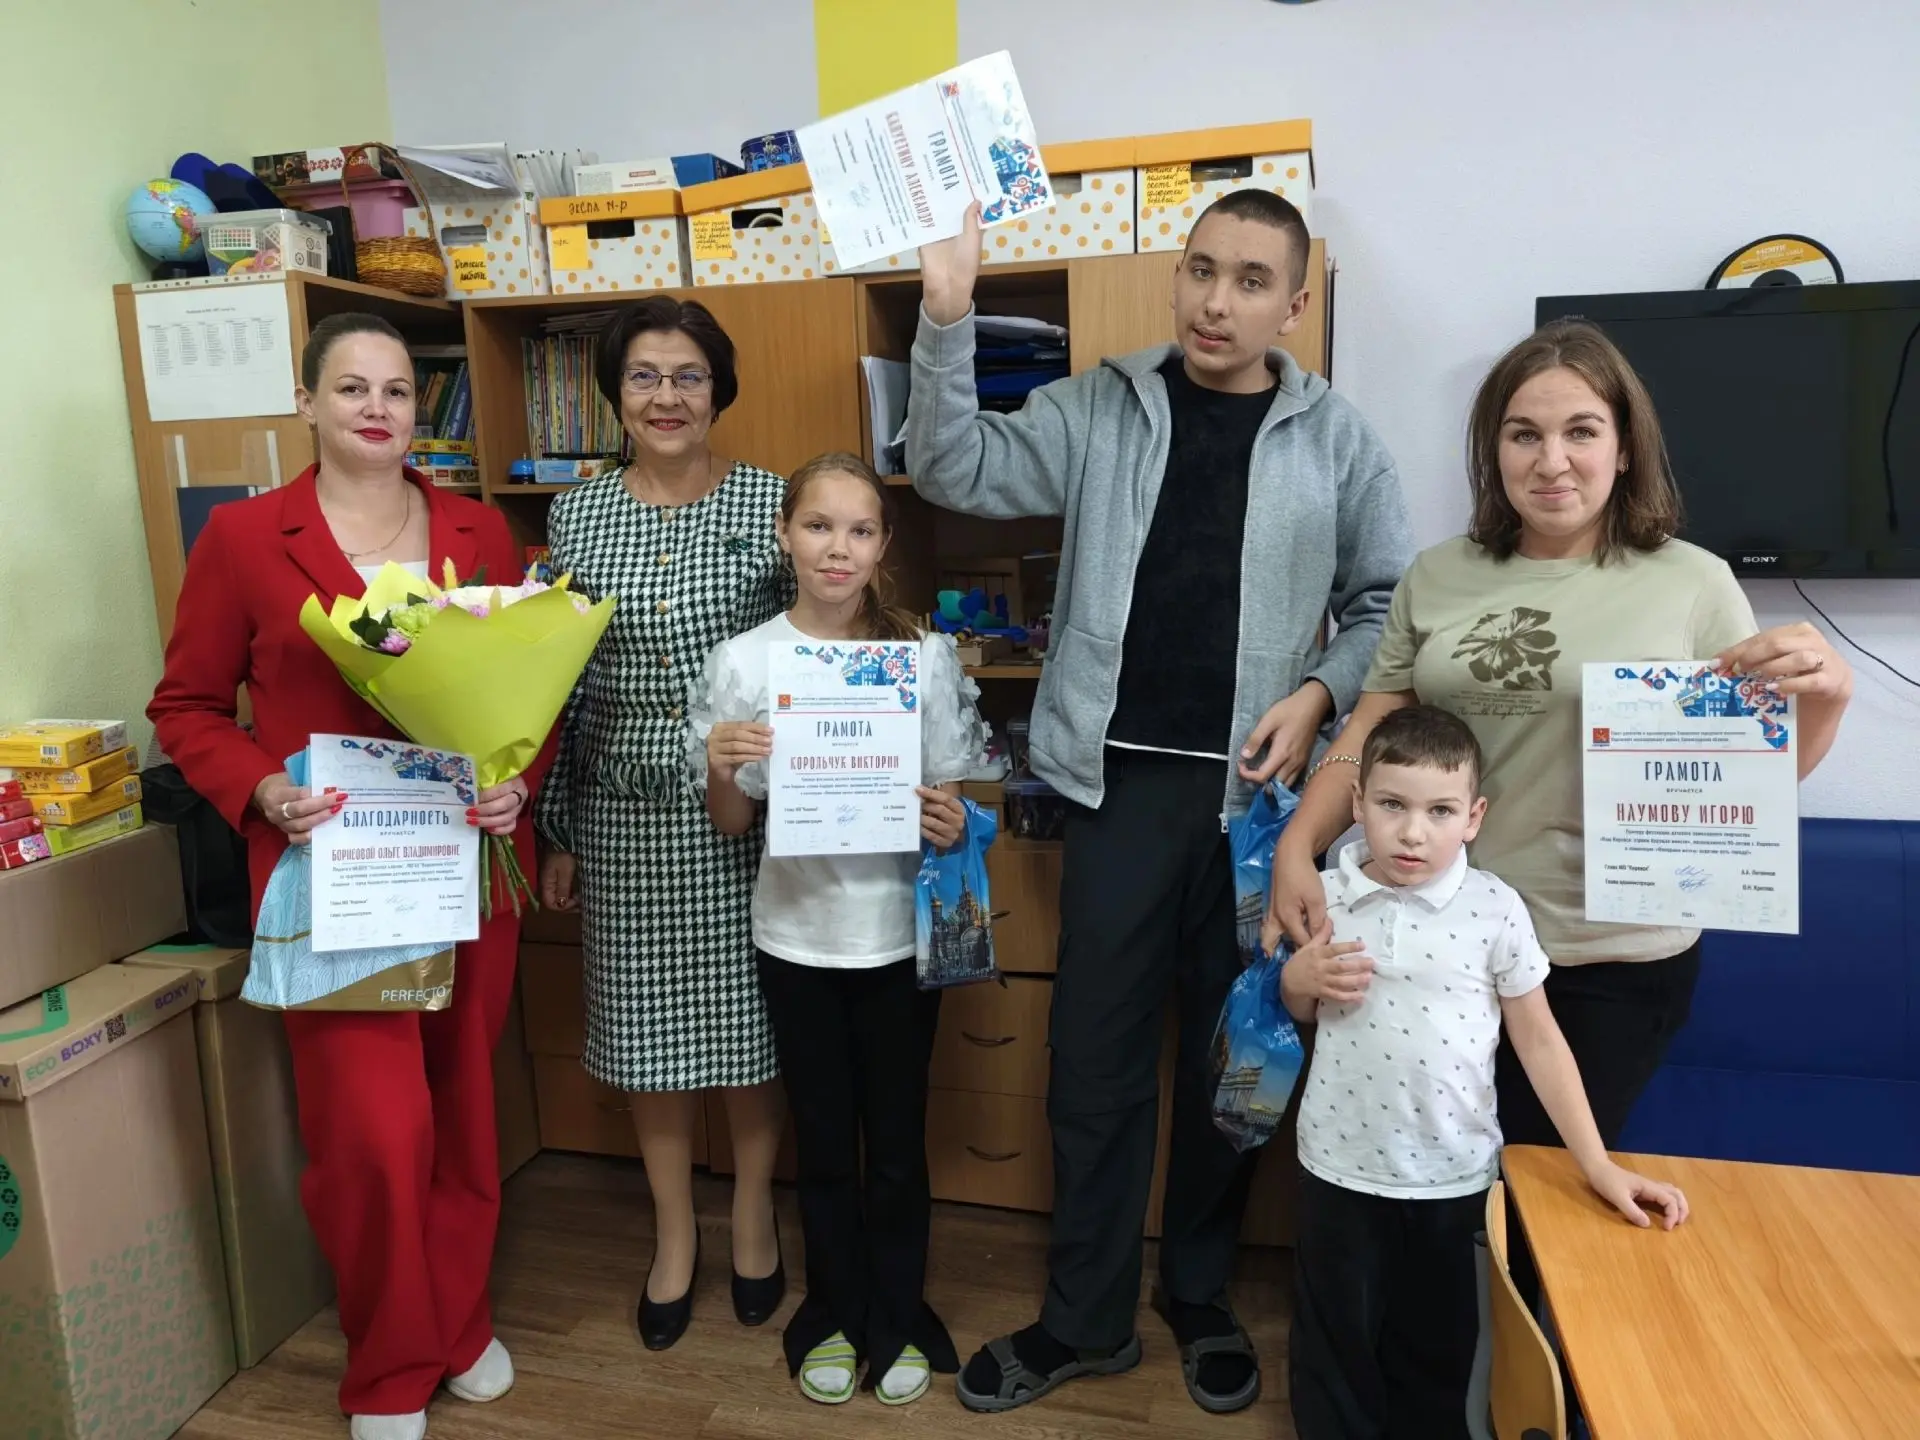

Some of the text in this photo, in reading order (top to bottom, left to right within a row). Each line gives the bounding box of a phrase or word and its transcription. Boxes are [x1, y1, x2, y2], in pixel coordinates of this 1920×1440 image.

[927, 129, 960, 191] ГРАМОТА
[904, 171, 936, 229] АЛЕКСАНДРУ
[817, 720, 873, 738] ГРАМОТА
[790, 755, 900, 770] КОРОЛЬЧУК ВИКТОРИИ
[1644, 761, 1722, 782] ГРАМОТА
[343, 810, 450, 828] БЛАГОДАРНОСТЬ
[1616, 803, 1754, 825] НАУМОВУ ИГОРЮ
[378, 846, 401, 859] ОЛЬГЕ
[402, 844, 461, 858] ВЛАДИМИРОВНЕ
[154, 981, 190, 1010] BOXY
[381, 985, 446, 1002] PERFECTO
[25, 1029, 104, 1080] ECO BOXY
